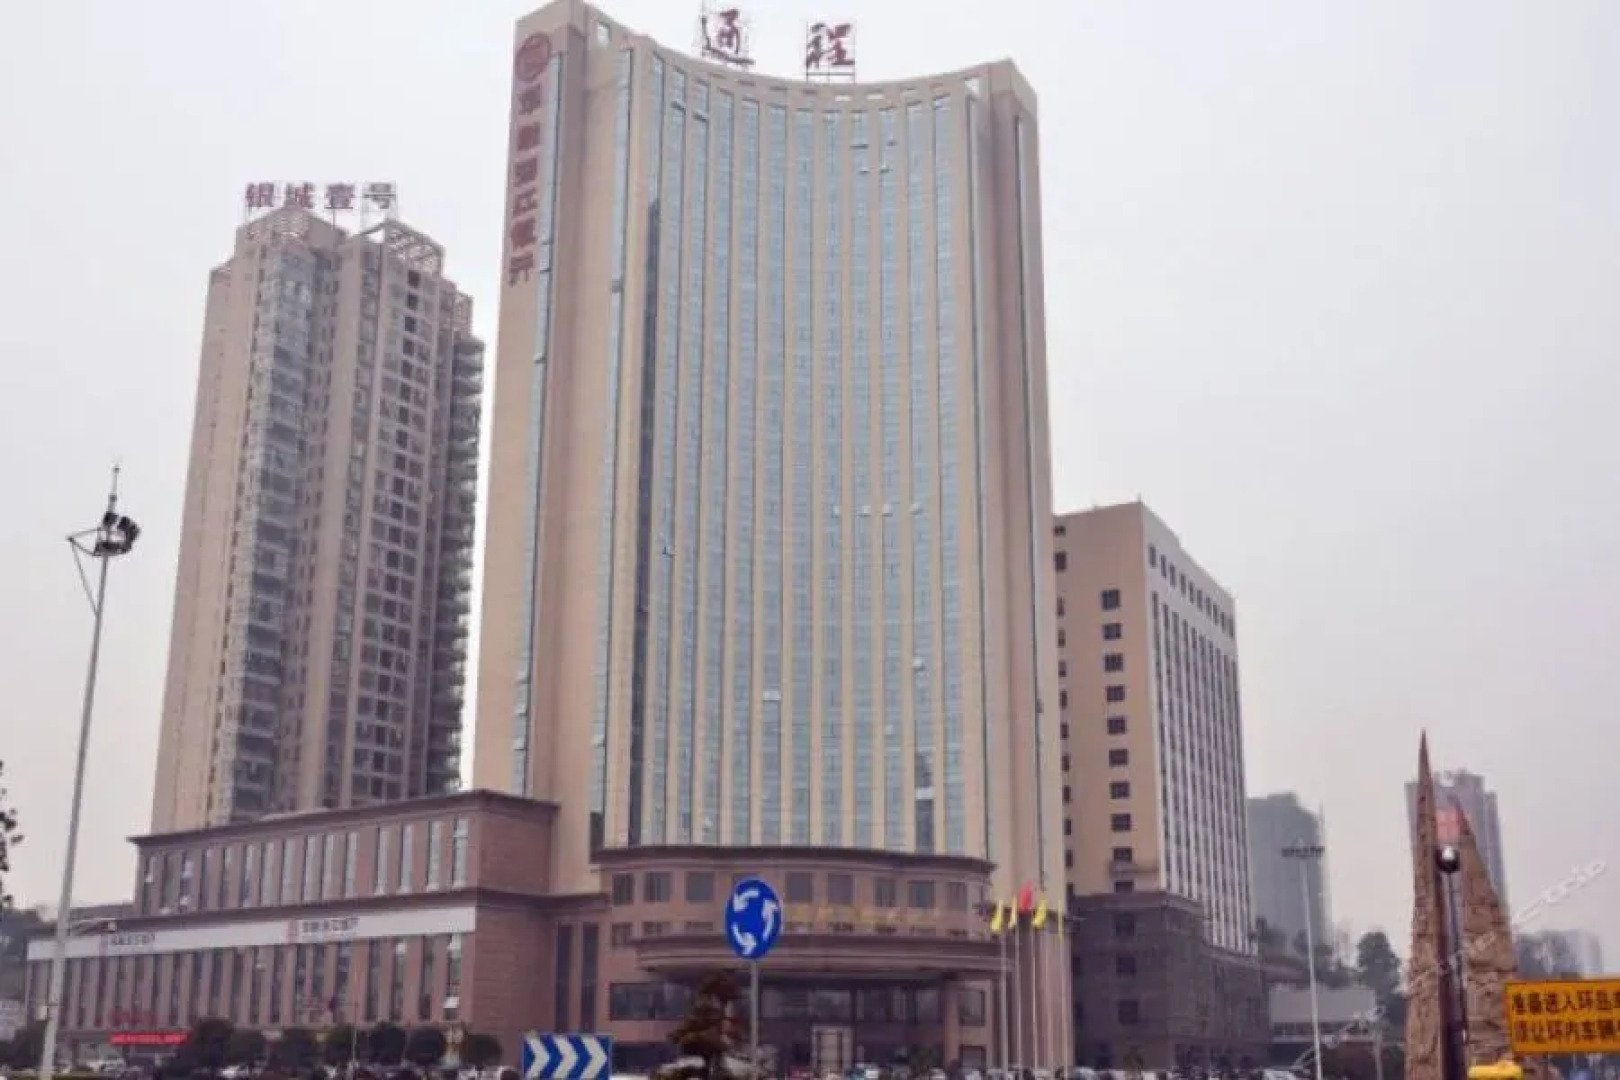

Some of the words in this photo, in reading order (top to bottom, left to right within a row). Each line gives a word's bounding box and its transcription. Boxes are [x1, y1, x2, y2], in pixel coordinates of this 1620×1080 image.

[700, 8, 856, 70] 通程
[1514, 1019, 1620, 1044] 须让环内车辆
